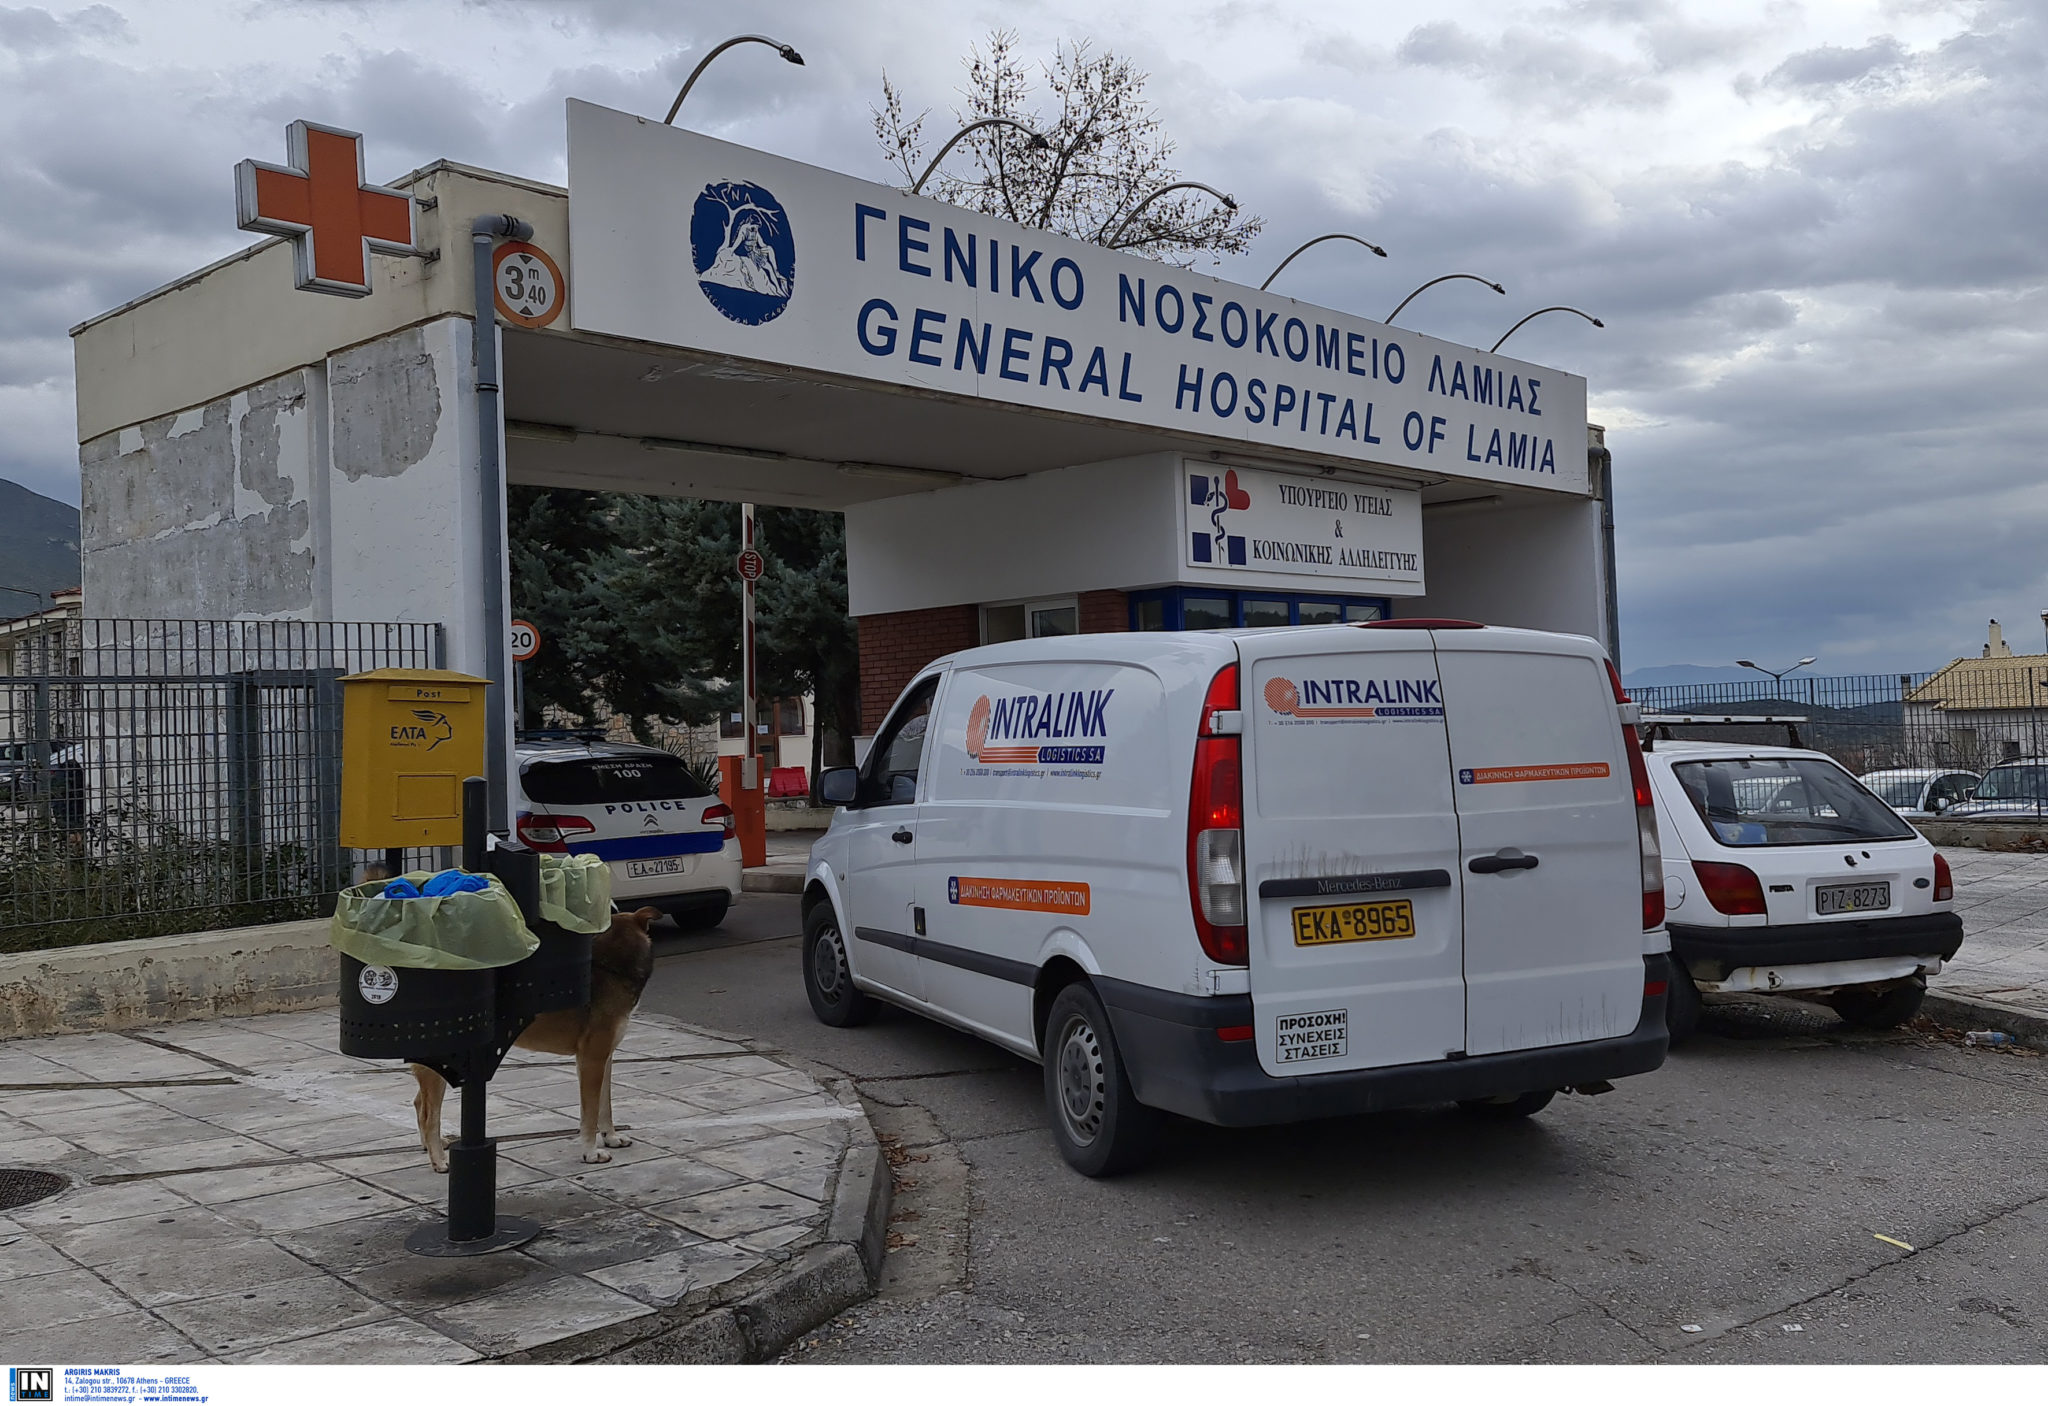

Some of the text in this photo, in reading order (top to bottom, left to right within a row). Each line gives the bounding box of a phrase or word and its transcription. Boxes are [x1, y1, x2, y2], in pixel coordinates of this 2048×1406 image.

[855, 202, 1543, 417] ΓΕΝΙΚΟ ΝΟΣΟΚΟΜΕΙΟ ΛΑΜΙΑΣ
[857, 298, 1556, 475] GENERAL HOSPITAL OF LAMIA
[1278, 484, 1393, 518] ΥΠΟΥΡΓΕΙΟ ΥΓΕΙΑΣ
[1334, 519, 1344, 539] &
[1253, 539, 1418, 572] ΚΟΙΝΩΝΙΚΗΣ ΑΛΛΗΛΕΓΓΥΗΣ
[744, 553, 757, 578] STOP
[416, 689, 441, 698] Post
[1303, 680, 1441, 704] INTRALINK
[990, 689, 1115, 740] INTRALINK
[1378, 708, 1426, 716] LOGISTICS
[390, 726, 427, 740] ΕΛΤΑ
[1041, 747, 1086, 762] LOGISTICS
[613, 769, 641, 779] 100
[1476, 770, 1513, 781] ΔΙΑΚΙΝΗΣΗ
[605, 800, 686, 815] POLICE
[960, 885, 991, 899] ΔΙΑΚΙΝΗΣΗ
[992, 887, 1042, 903] ΦΑΡΜΑΚΕΥΤΙΚΩΝ
[1317, 877, 1401, 894] Mercedes-Benz
[1298, 904, 1411, 941] EKA-8965
[1279, 1012, 1346, 1031] ΠΡΟΣΟΧΗ!
[1279, 1028, 1346, 1046] ΣΥΝΕΧΕΙΣ
[1284, 1043, 1340, 1060] ΣΤΑΣΕΙΣ
